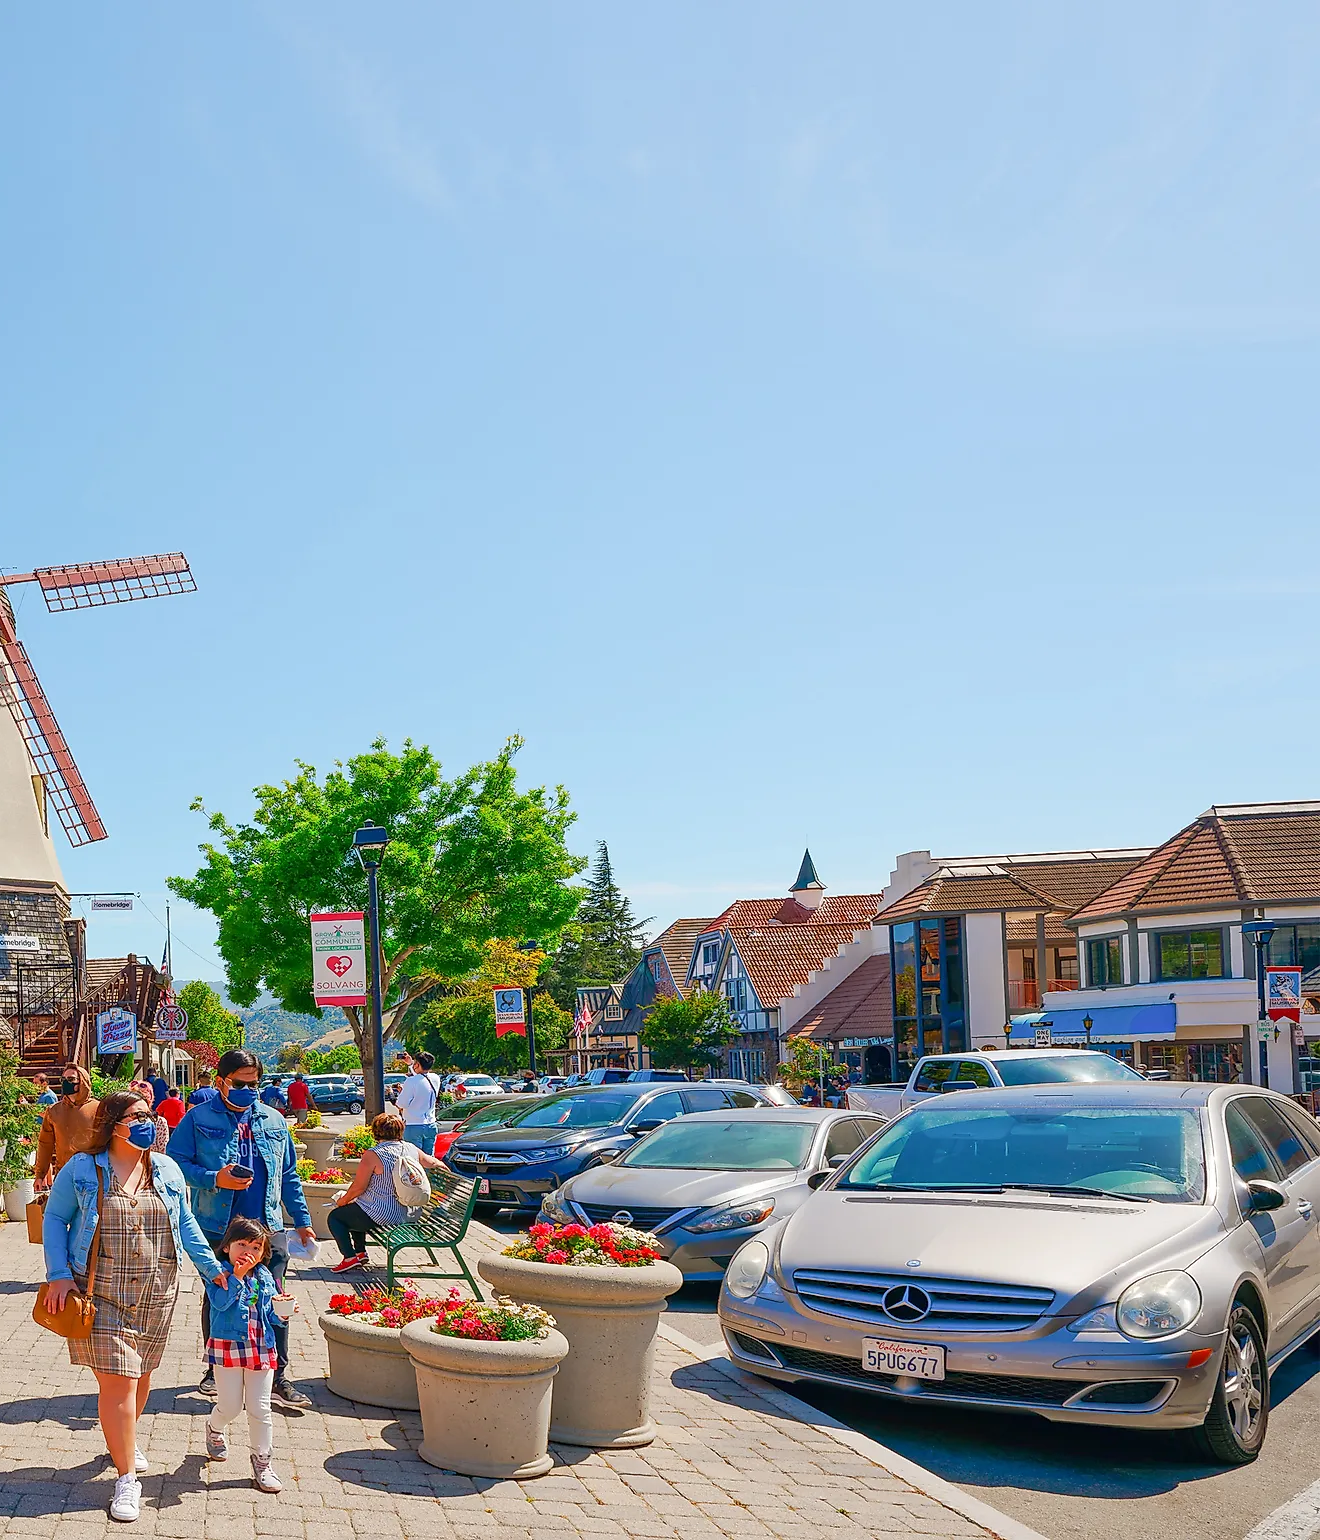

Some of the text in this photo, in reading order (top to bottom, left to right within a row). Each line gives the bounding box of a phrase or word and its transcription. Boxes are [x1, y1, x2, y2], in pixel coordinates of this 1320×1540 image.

[93, 901, 130, 910] Homebridge
[315, 937, 361, 946] COMMUNITY
[316, 980, 364, 990] SOLVANG
[103, 1020, 130, 1032] Tower
[103, 1029, 132, 1044] Pizza
[878, 1342, 928, 1355] California
[867, 1350, 939, 1374] 5PUG677
